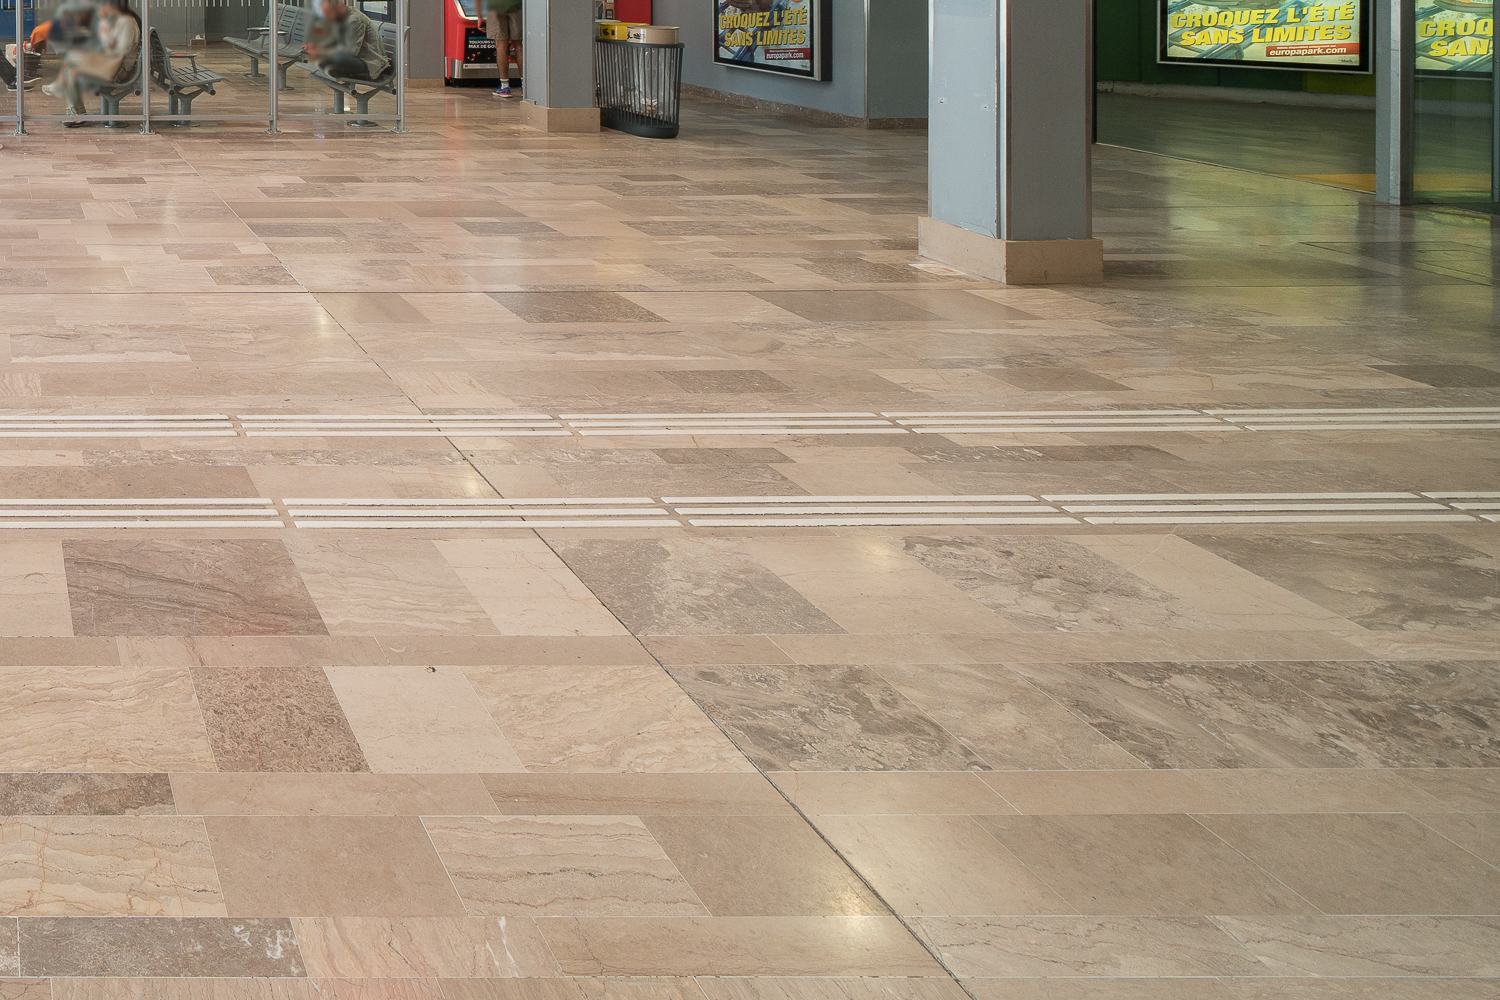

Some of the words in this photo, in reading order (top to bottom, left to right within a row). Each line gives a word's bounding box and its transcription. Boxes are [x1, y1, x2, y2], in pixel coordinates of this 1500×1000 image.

[719, 11, 771, 30] CROQUEZ
[773, 5, 808, 28] L'ÉTÉ
[1171, 8, 1280, 29] CROQUEZ
[1286, 1, 1356, 23] L'ÉTÉ
[724, 30, 754, 47] SANS
[756, 28, 806, 46] LIMITES
[1180, 29, 1245, 46] SANS
[1251, 24, 1352, 43] LIMITES
[766, 51, 804, 60] europapark.com
[1269, 47, 1347, 57] europapark.com
[1429, 39, 1494, 57] SAN
